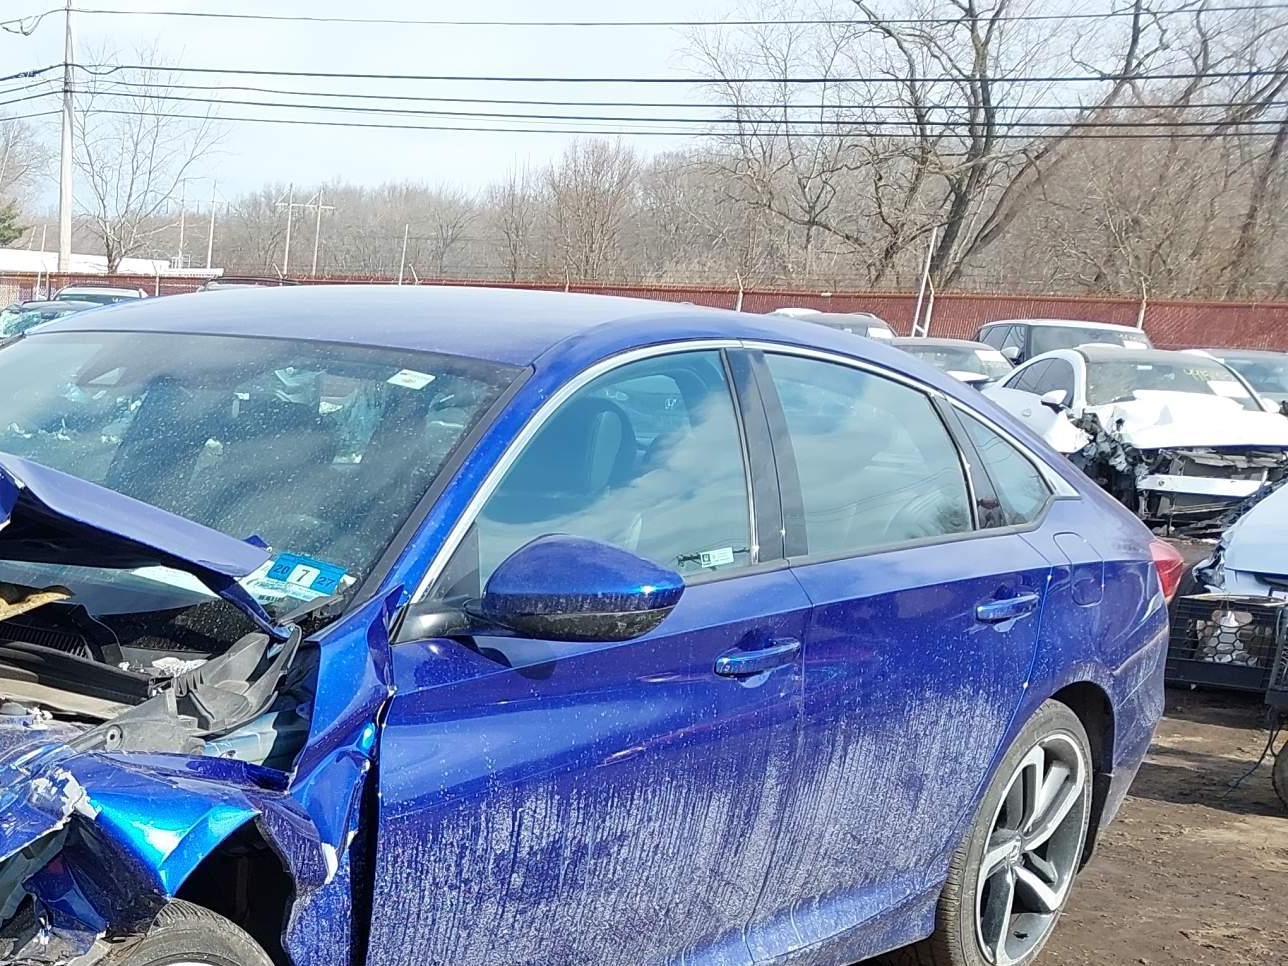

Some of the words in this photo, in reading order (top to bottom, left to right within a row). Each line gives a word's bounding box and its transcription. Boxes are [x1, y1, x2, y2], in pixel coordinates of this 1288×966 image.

[273, 564, 290, 575] 20
[296, 568, 311, 582] 7
[317, 576, 336, 588] 27
